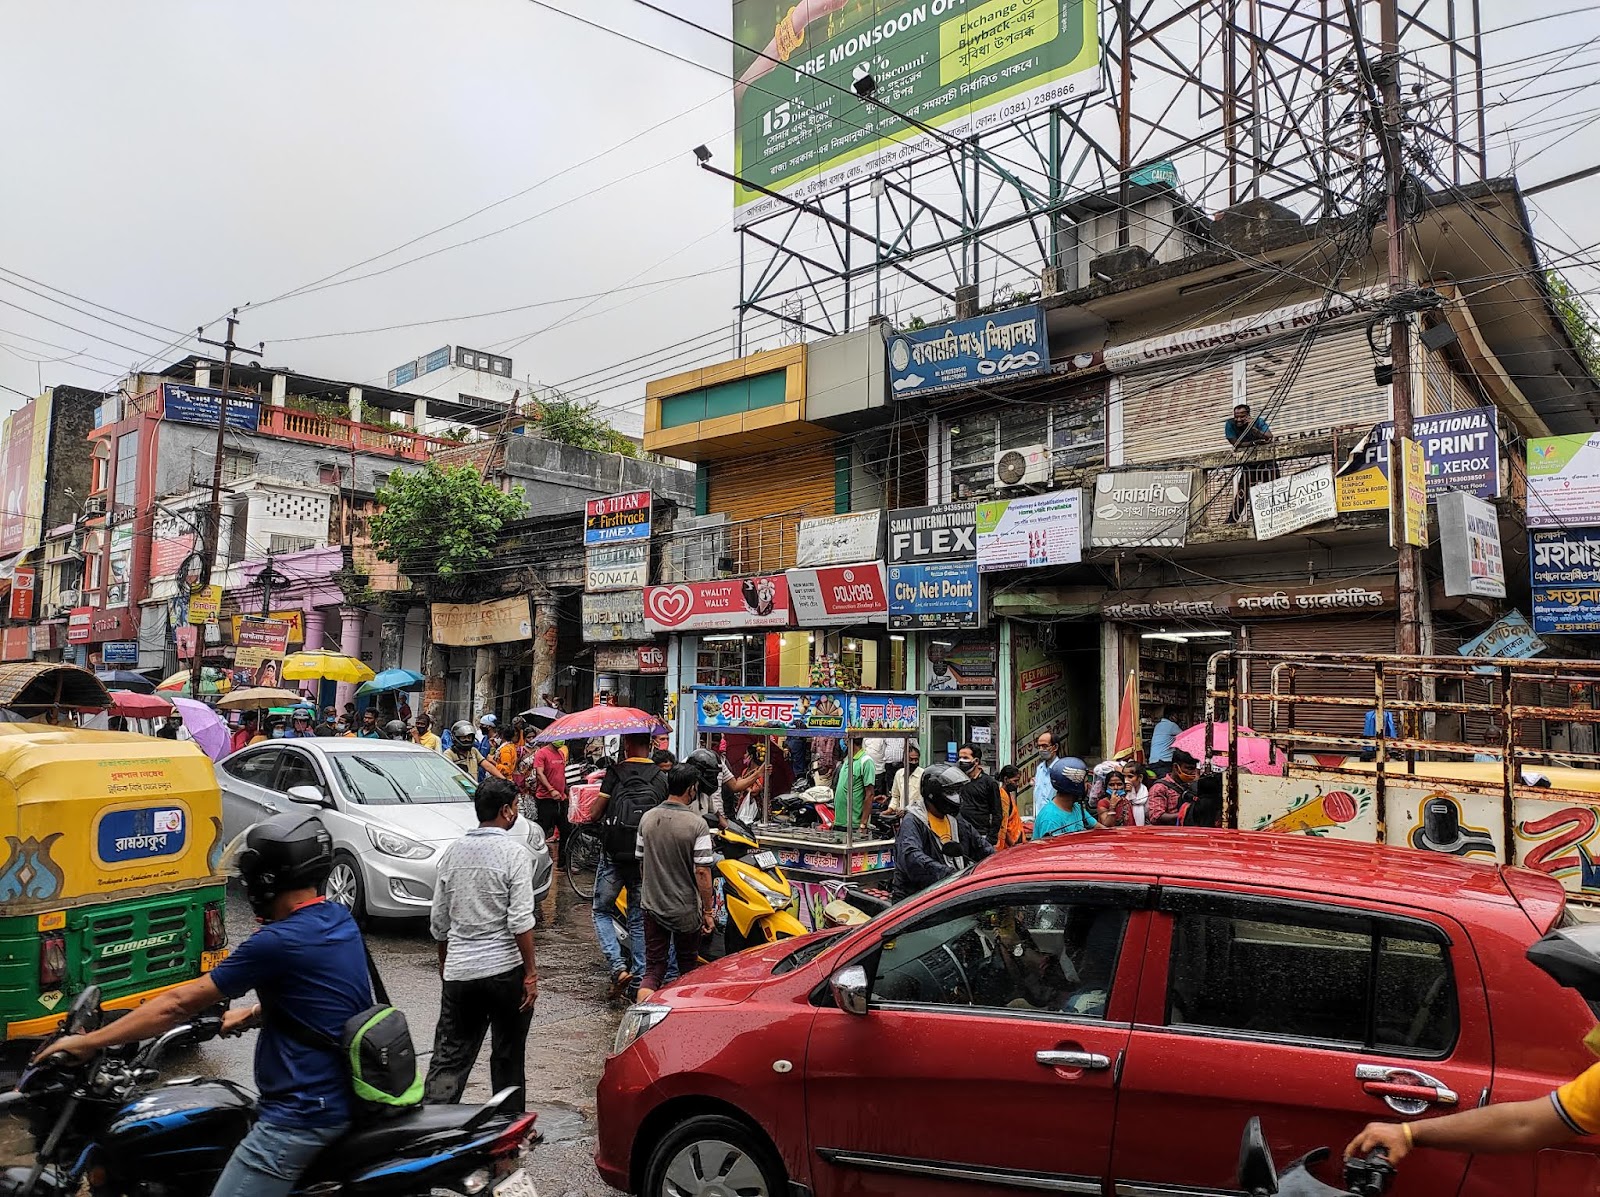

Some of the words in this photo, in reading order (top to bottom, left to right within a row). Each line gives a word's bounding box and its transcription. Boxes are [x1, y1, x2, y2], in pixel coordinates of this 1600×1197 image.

[960, 5, 1017, 34] Exchange
[795, 58, 827, 84] PRE
[829, 12, 928, 66] MONSOON
[873, 54, 927, 84] Discount
[1001, 60, 1032, 78] থাকবে
[893, 84, 915, 102] উপর
[999, 95, 1032, 121] (0381)
[1033, 82, 1076, 106] 2388866
[791, 97, 833, 123] Discount
[911, 329, 959, 366] বাবামনি
[1382, 413, 1489, 441] INRNATIONAL
[1428, 431, 1489, 457] PRINT
[1442, 456, 1490, 474] XEROX
[1260, 480, 1286, 491] PLEASE
[1268, 477, 1330, 508] INLAND
[608, 493, 639, 513] TITAN
[1260, 501, 1297, 518] COURIERS
[1308, 491, 1325, 502] LTD.
[1352, 499, 1377, 507] SOLVENT
[600, 509, 646, 529] Firsttrack
[853, 512, 879, 524] STORES
[890, 517, 913, 533] SAHA
[913, 510, 977, 531] INTERNATIONAL
[599, 526, 636, 539] TIMEX
[891, 525, 977, 561] FLEX
[610, 546, 645, 562] TITAN
[589, 570, 639, 588] SONATA
[1534, 571, 1561, 582] এখানে
[700, 587, 733, 598] KWALITY
[833, 583, 874, 603] POLYCAB
[895, 582, 918, 604] City
[919, 581, 940, 599] Net
[941, 579, 974, 598] Point
[704, 598, 730, 608] WALL'S
[918, 613, 942, 622] COLOUR
[640, 647, 665, 667] ঘড়ি
[1022, 670, 1037, 683] FLEX
[1036, 663, 1063, 679] PRINTING
[721, 695, 744, 720] श्री
[743, 695, 796, 725] मेवाड़
[859, 703, 885, 720] बादाम
[885, 697, 903, 719] शेक
[115, 833, 168, 852] রামঠাকুর
[803, 851, 840, 870] आईस्क्रीम
[101, 931, 178, 956] Compact
[43, 992, 60, 1003] CNG
